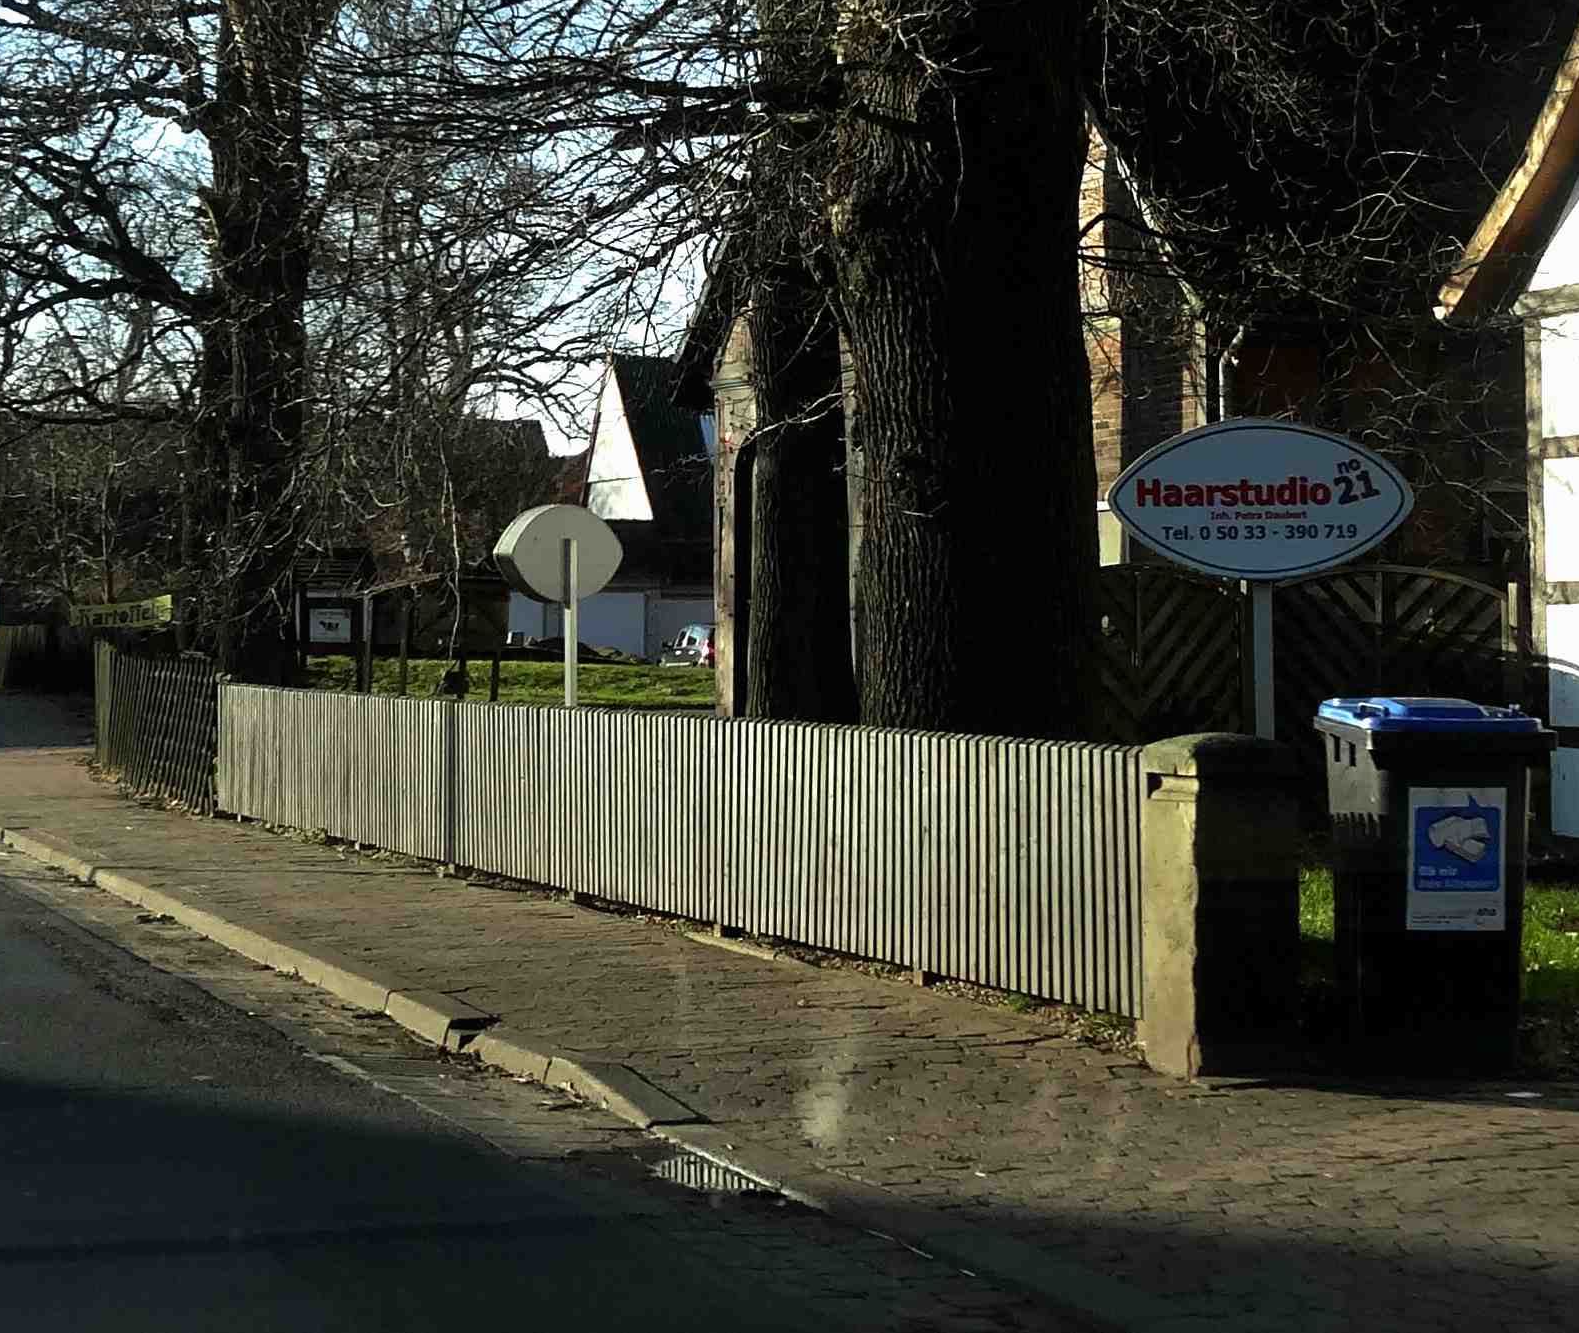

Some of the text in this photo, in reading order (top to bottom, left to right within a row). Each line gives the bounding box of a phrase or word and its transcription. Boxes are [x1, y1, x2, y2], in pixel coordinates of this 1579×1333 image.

[1135, 469, 1381, 508] Haarstudio 21
[1162, 526, 1193, 541] Tel.
[1199, 526, 1211, 541] 0
[1215, 526, 1239, 541] 50
[1243, 525, 1267, 540] 33
[1283, 525, 1319, 540] 390
[1324, 523, 1358, 539] 719
